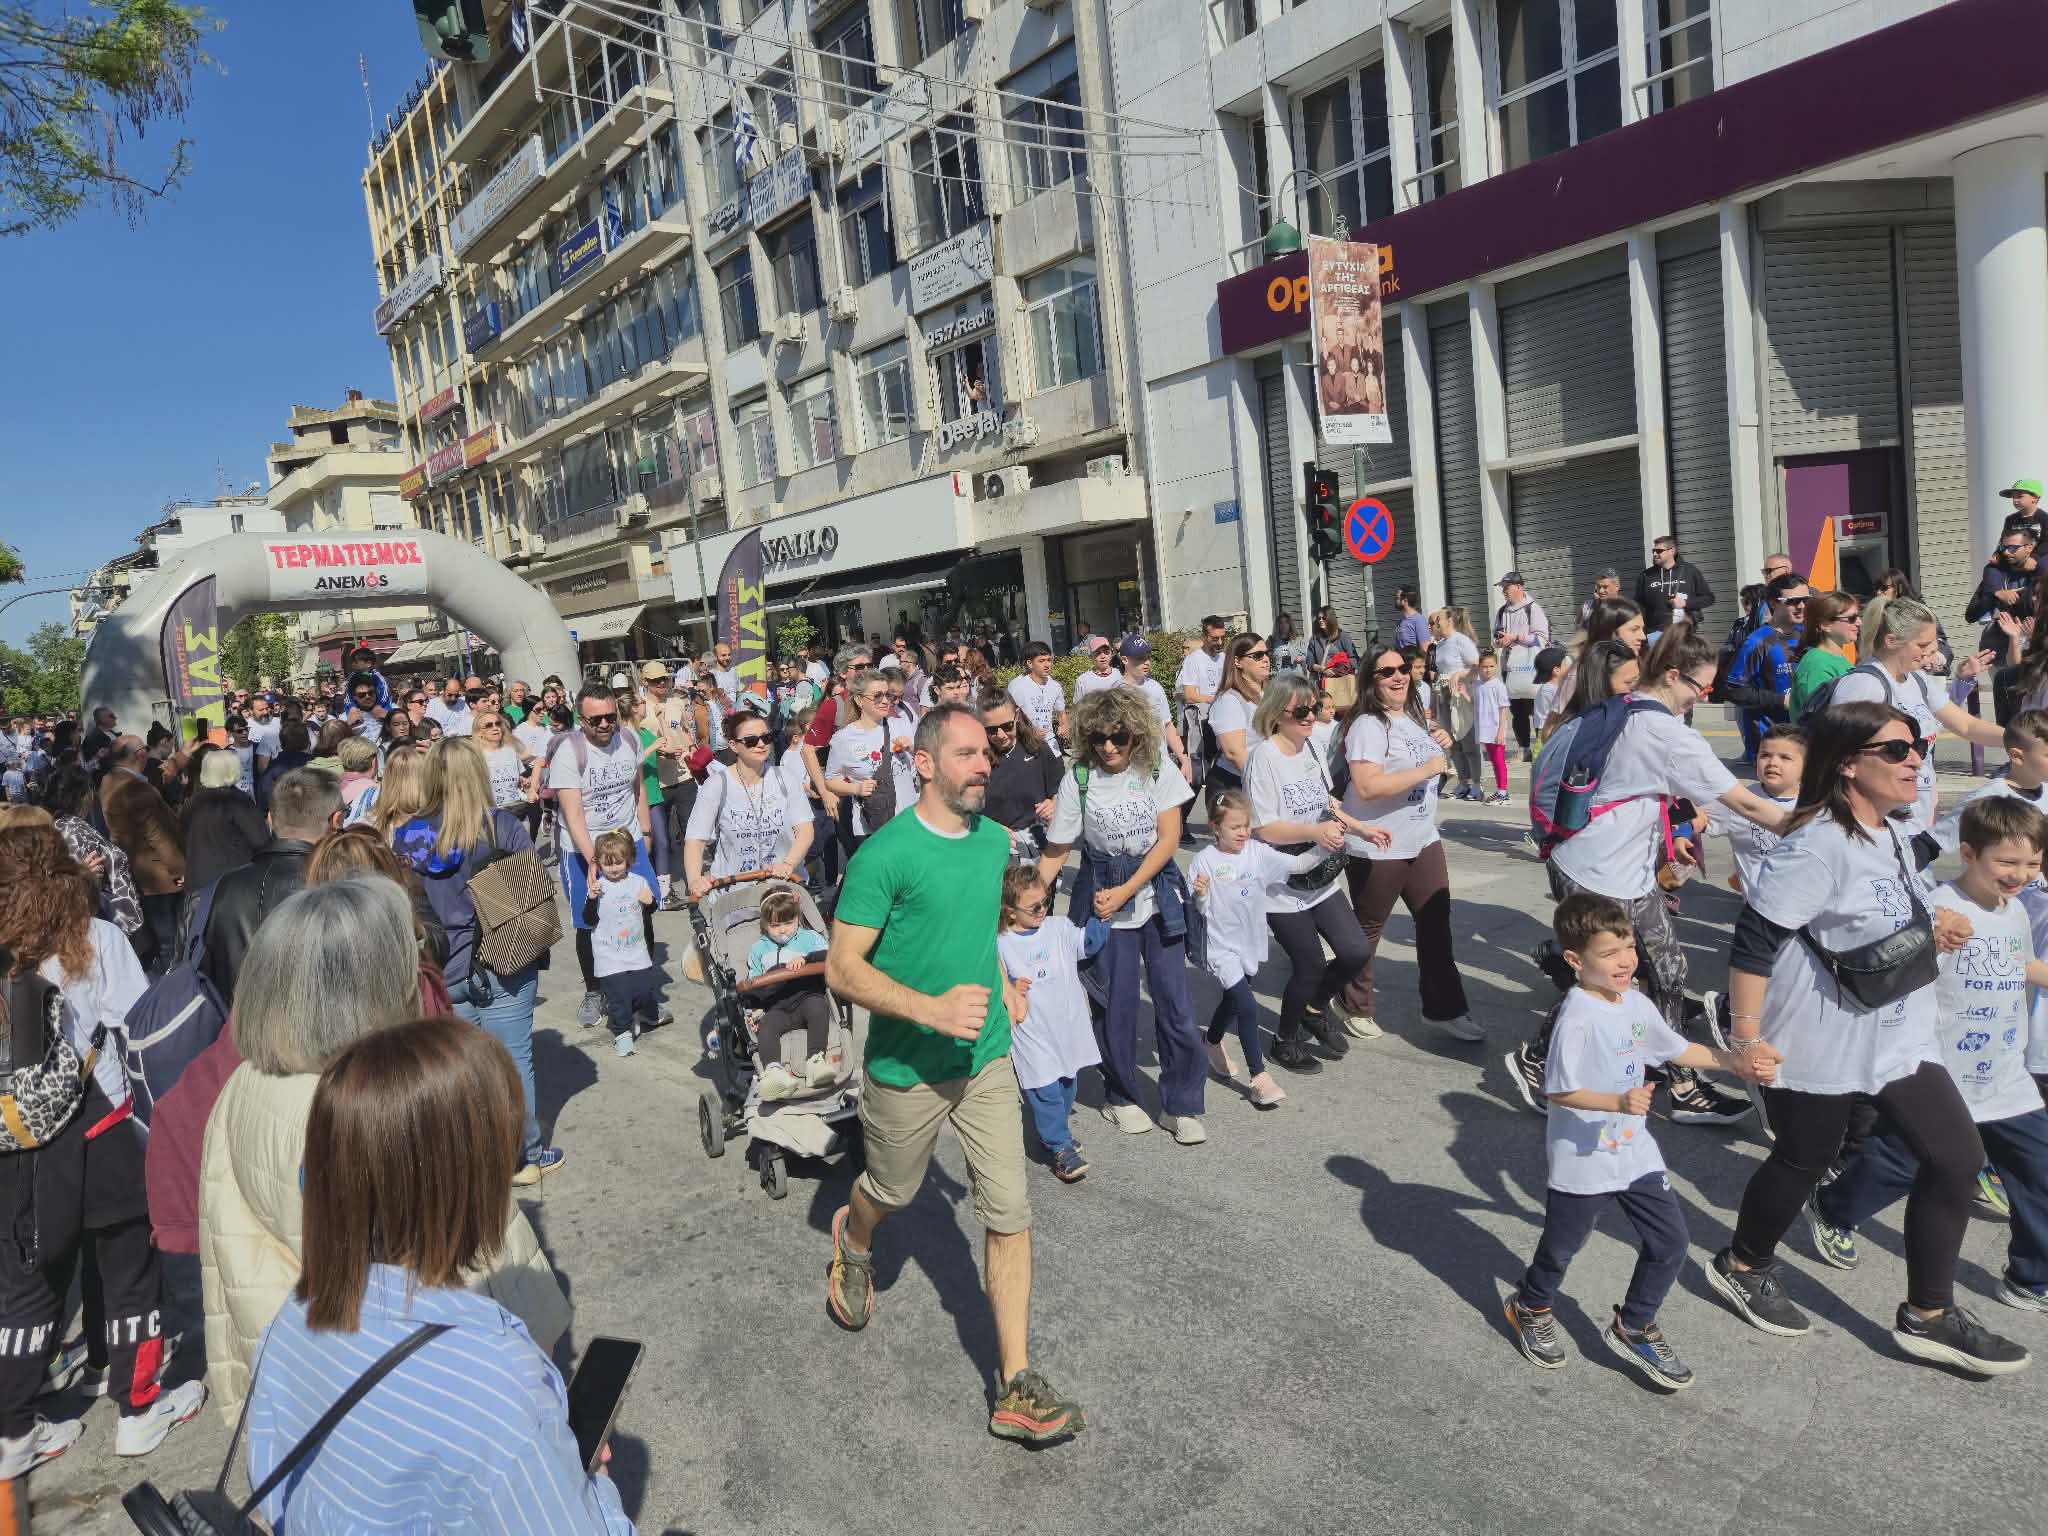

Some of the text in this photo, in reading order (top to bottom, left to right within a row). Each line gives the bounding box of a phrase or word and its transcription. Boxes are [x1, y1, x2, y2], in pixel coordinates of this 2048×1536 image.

[1267, 244, 1393, 314] Opa
[1320, 283, 1371, 295] ΑΡΓΙΘΕΑΣ
[1335, 272, 1356, 283] ΤΗΣ
[939, 409, 1005, 450] DeeJay
[269, 541, 422, 568] ΤΕΡΜΑΤΙΣΜΟΣ
[760, 525, 839, 566] VALLO
[1956, 937, 2025, 977] RU
[1964, 979, 2025, 992] FOR AUTIS
